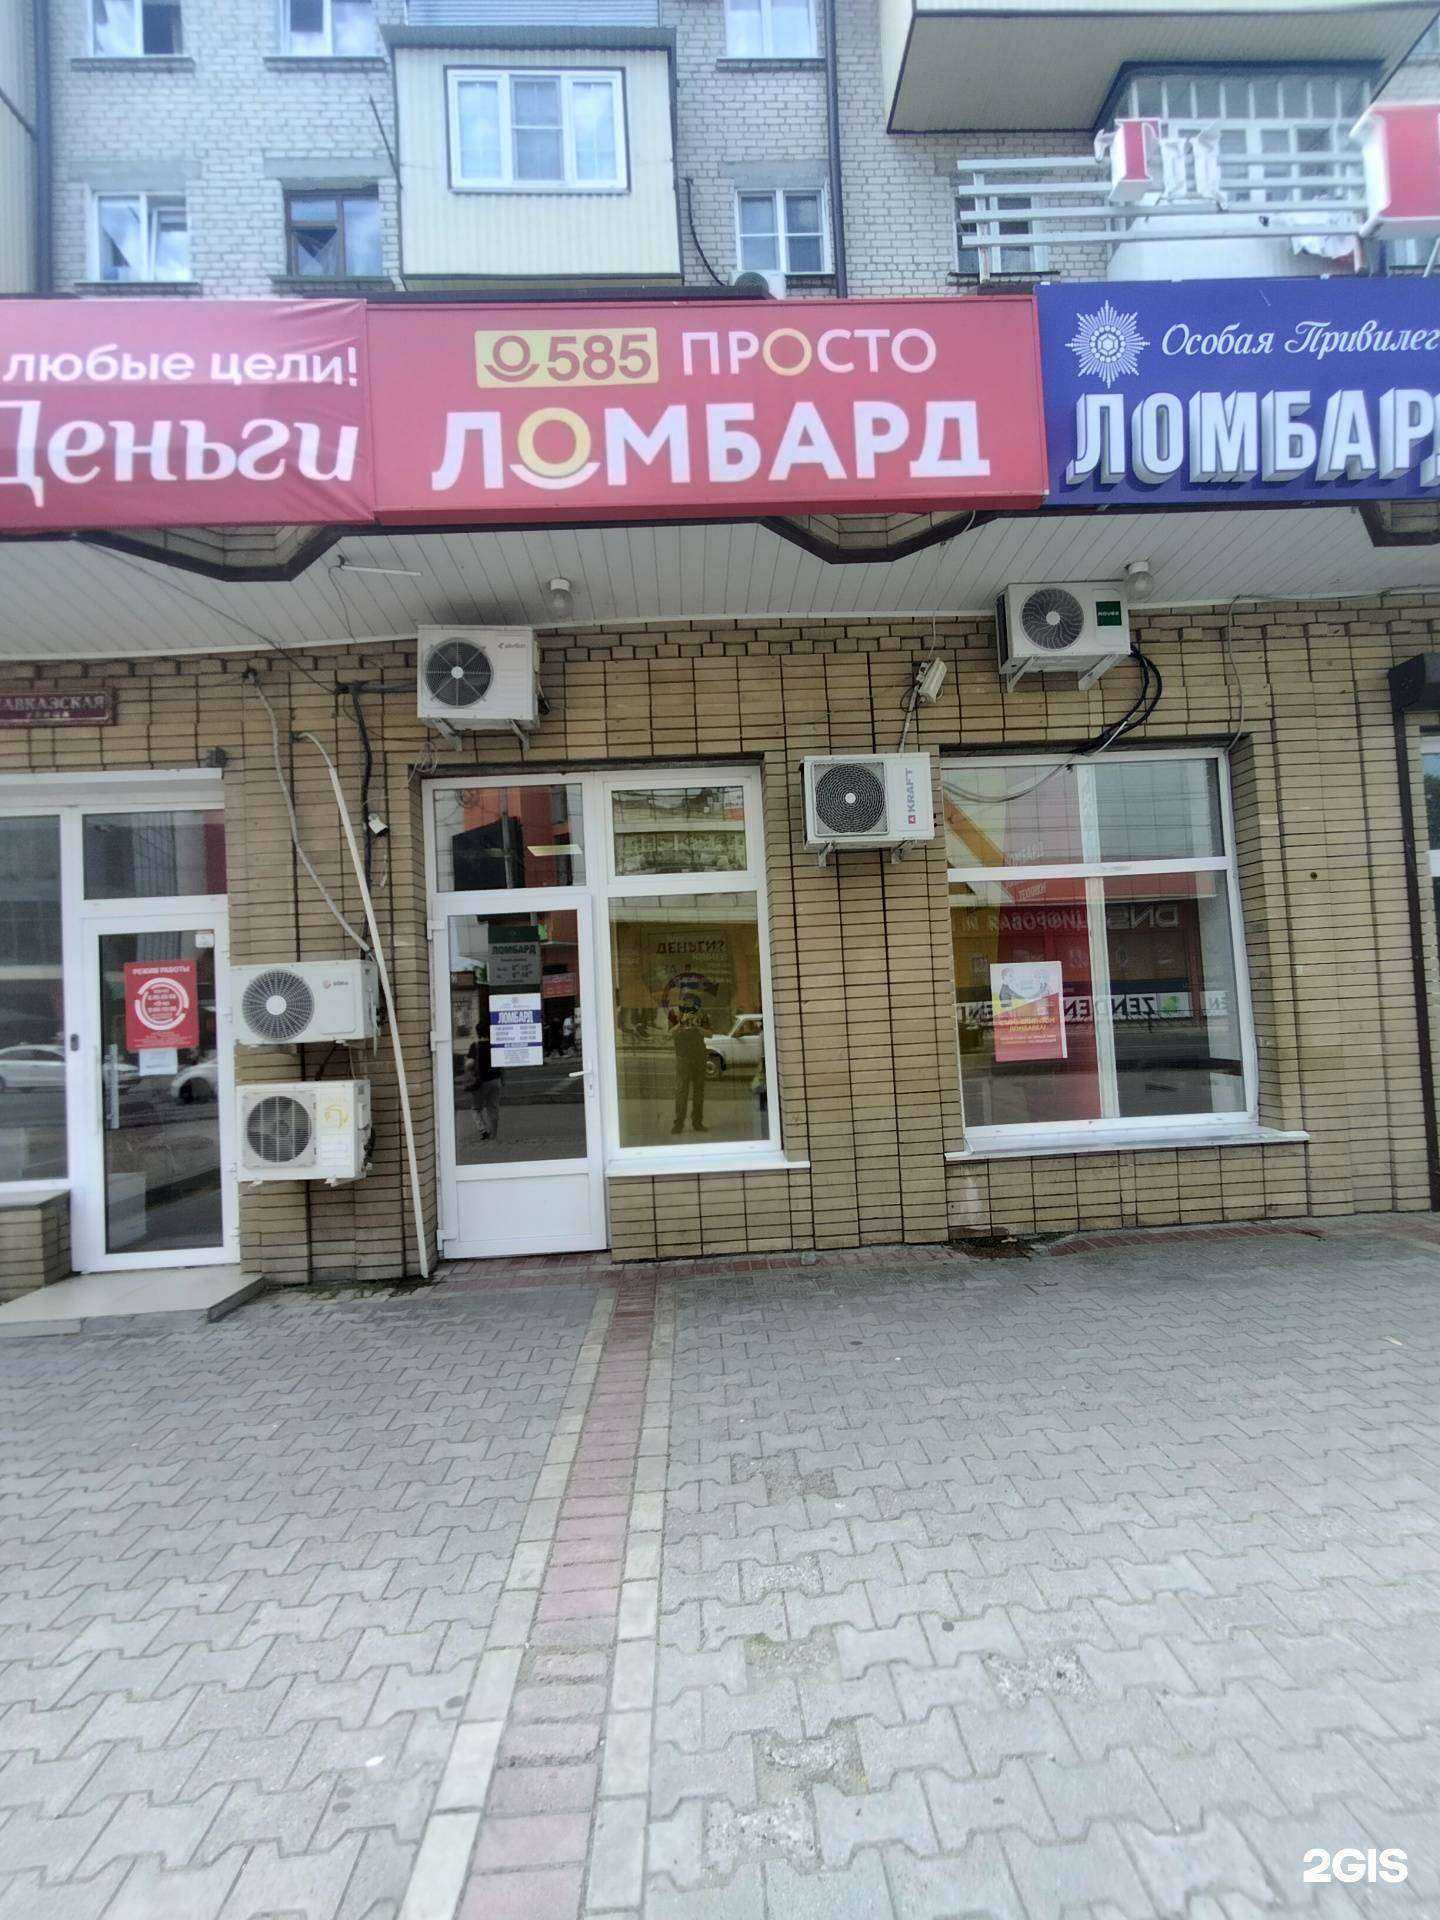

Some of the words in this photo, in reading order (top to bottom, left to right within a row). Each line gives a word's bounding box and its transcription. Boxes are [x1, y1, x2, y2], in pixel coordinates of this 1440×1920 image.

[547, 333, 652, 382] 585
[681, 327, 937, 377] ПРОСТО
[1161, 322, 1275, 357] Особая
[3, 343, 195, 383] любые
[210, 346, 359, 388] цели!
[431, 400, 991, 490] ЛОМБАРД
[905, 767, 916, 813] KRAFT
[497, 1009, 535, 1025] ЛОМБАРД
